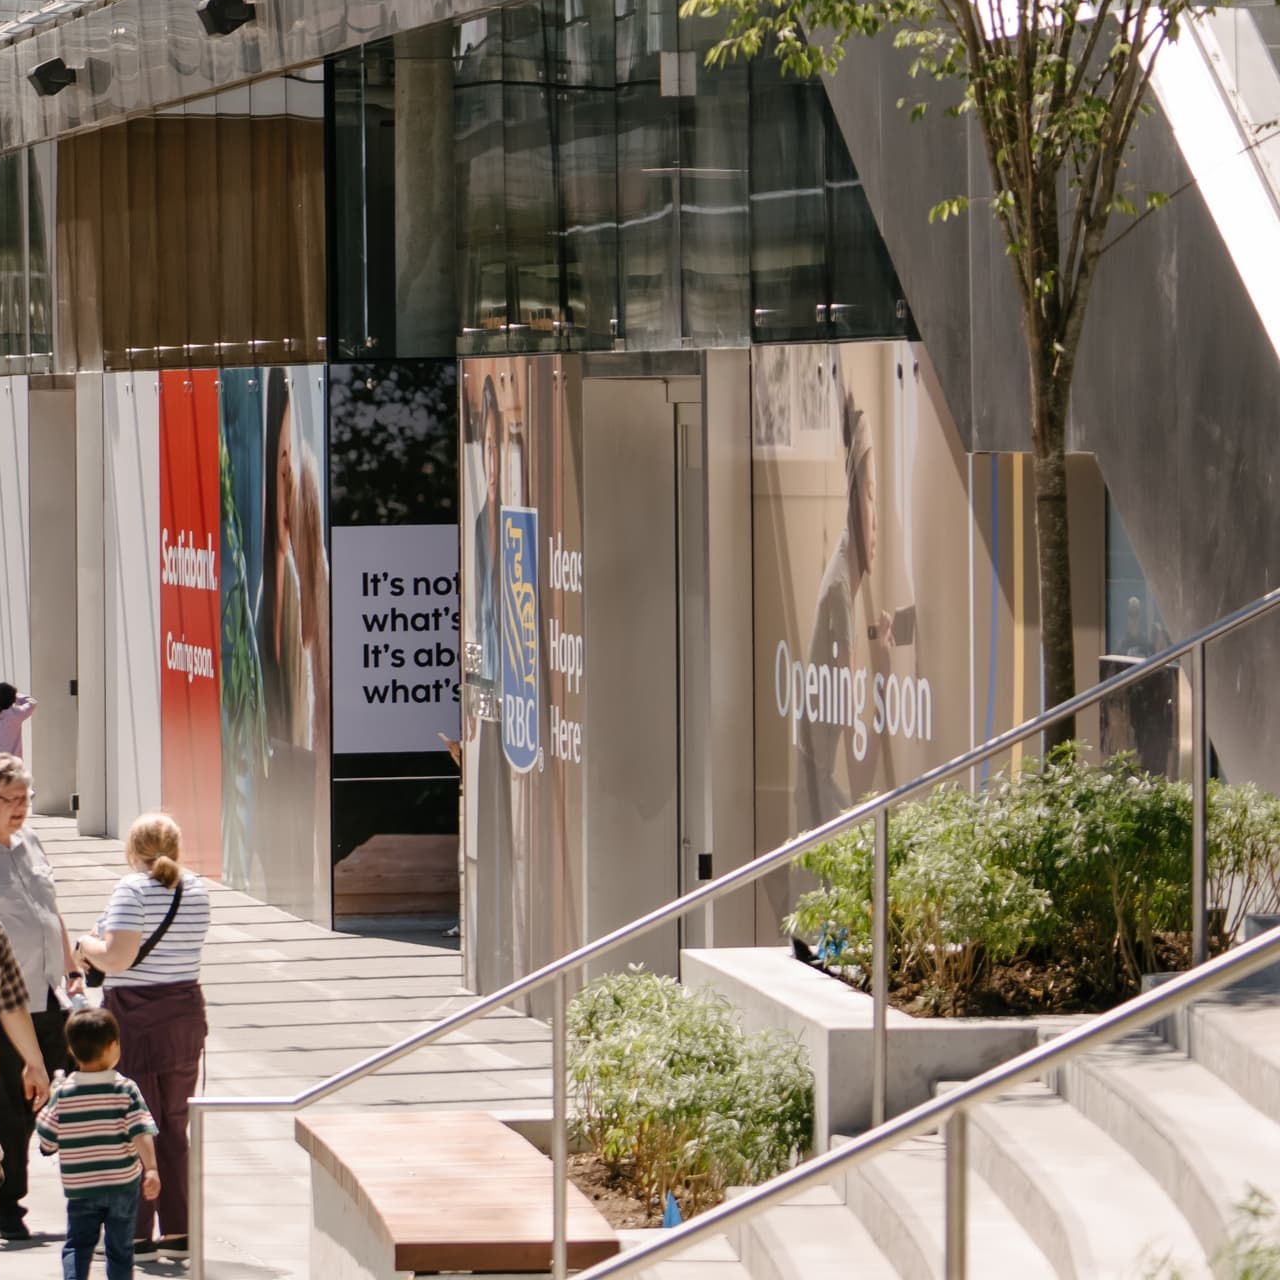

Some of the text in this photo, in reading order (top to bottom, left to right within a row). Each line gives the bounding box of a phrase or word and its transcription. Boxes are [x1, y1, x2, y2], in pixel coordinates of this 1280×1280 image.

[362, 572, 405, 596] It’s
[166, 631, 214, 683] Coming soon.
[363, 642, 460, 668] It’s ab
[549, 619, 583, 694] Happ
[505, 694, 536, 752] RBC
[775, 639, 932, 761] Opening soon
